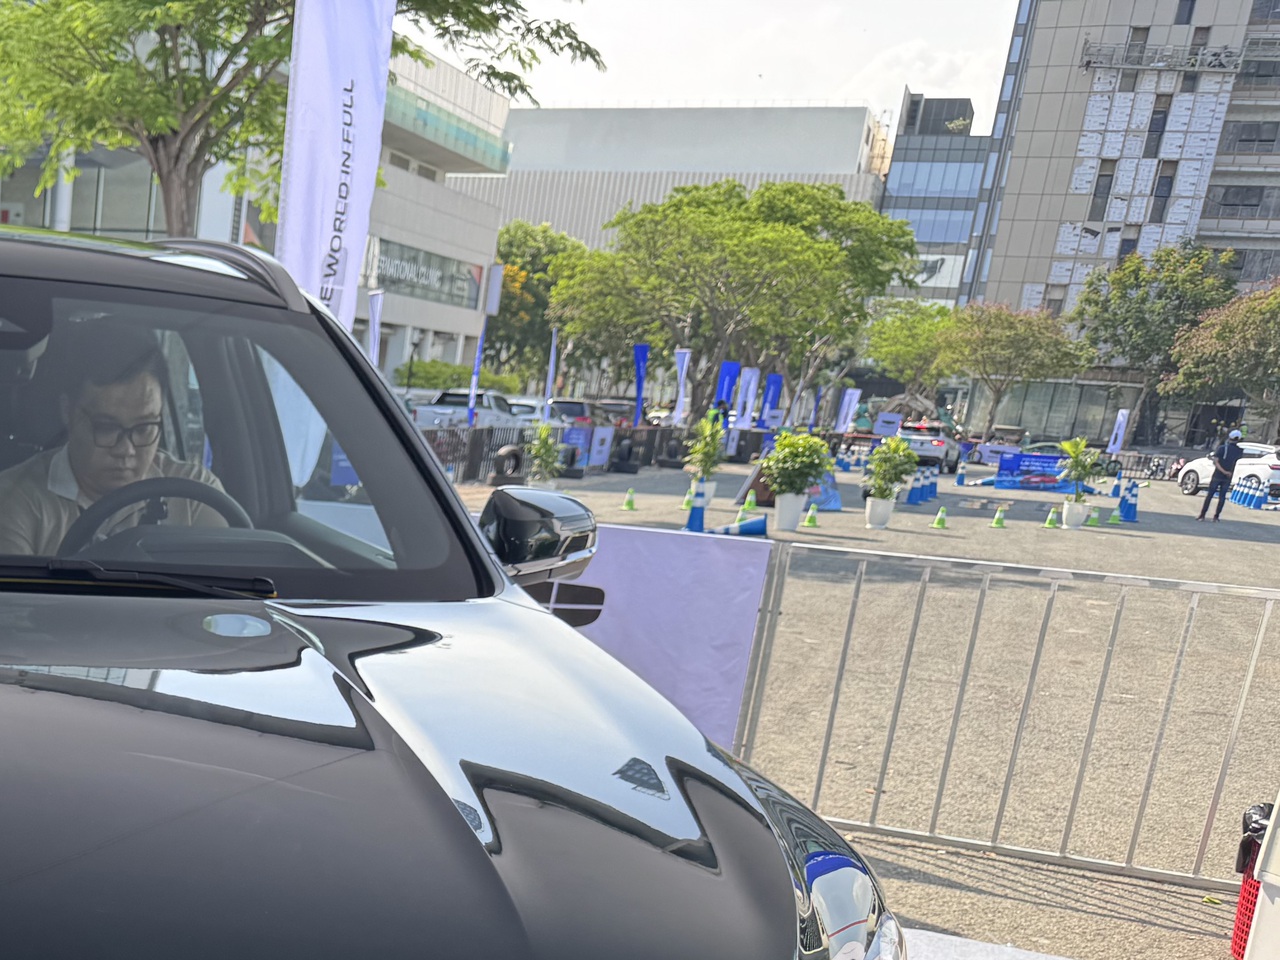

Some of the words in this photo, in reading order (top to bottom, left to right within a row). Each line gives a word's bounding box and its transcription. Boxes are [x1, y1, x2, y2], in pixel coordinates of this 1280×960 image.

[342, 79, 355, 144] FULL
[340, 151, 352, 175] IN
[323, 182, 349, 278] WORLD
